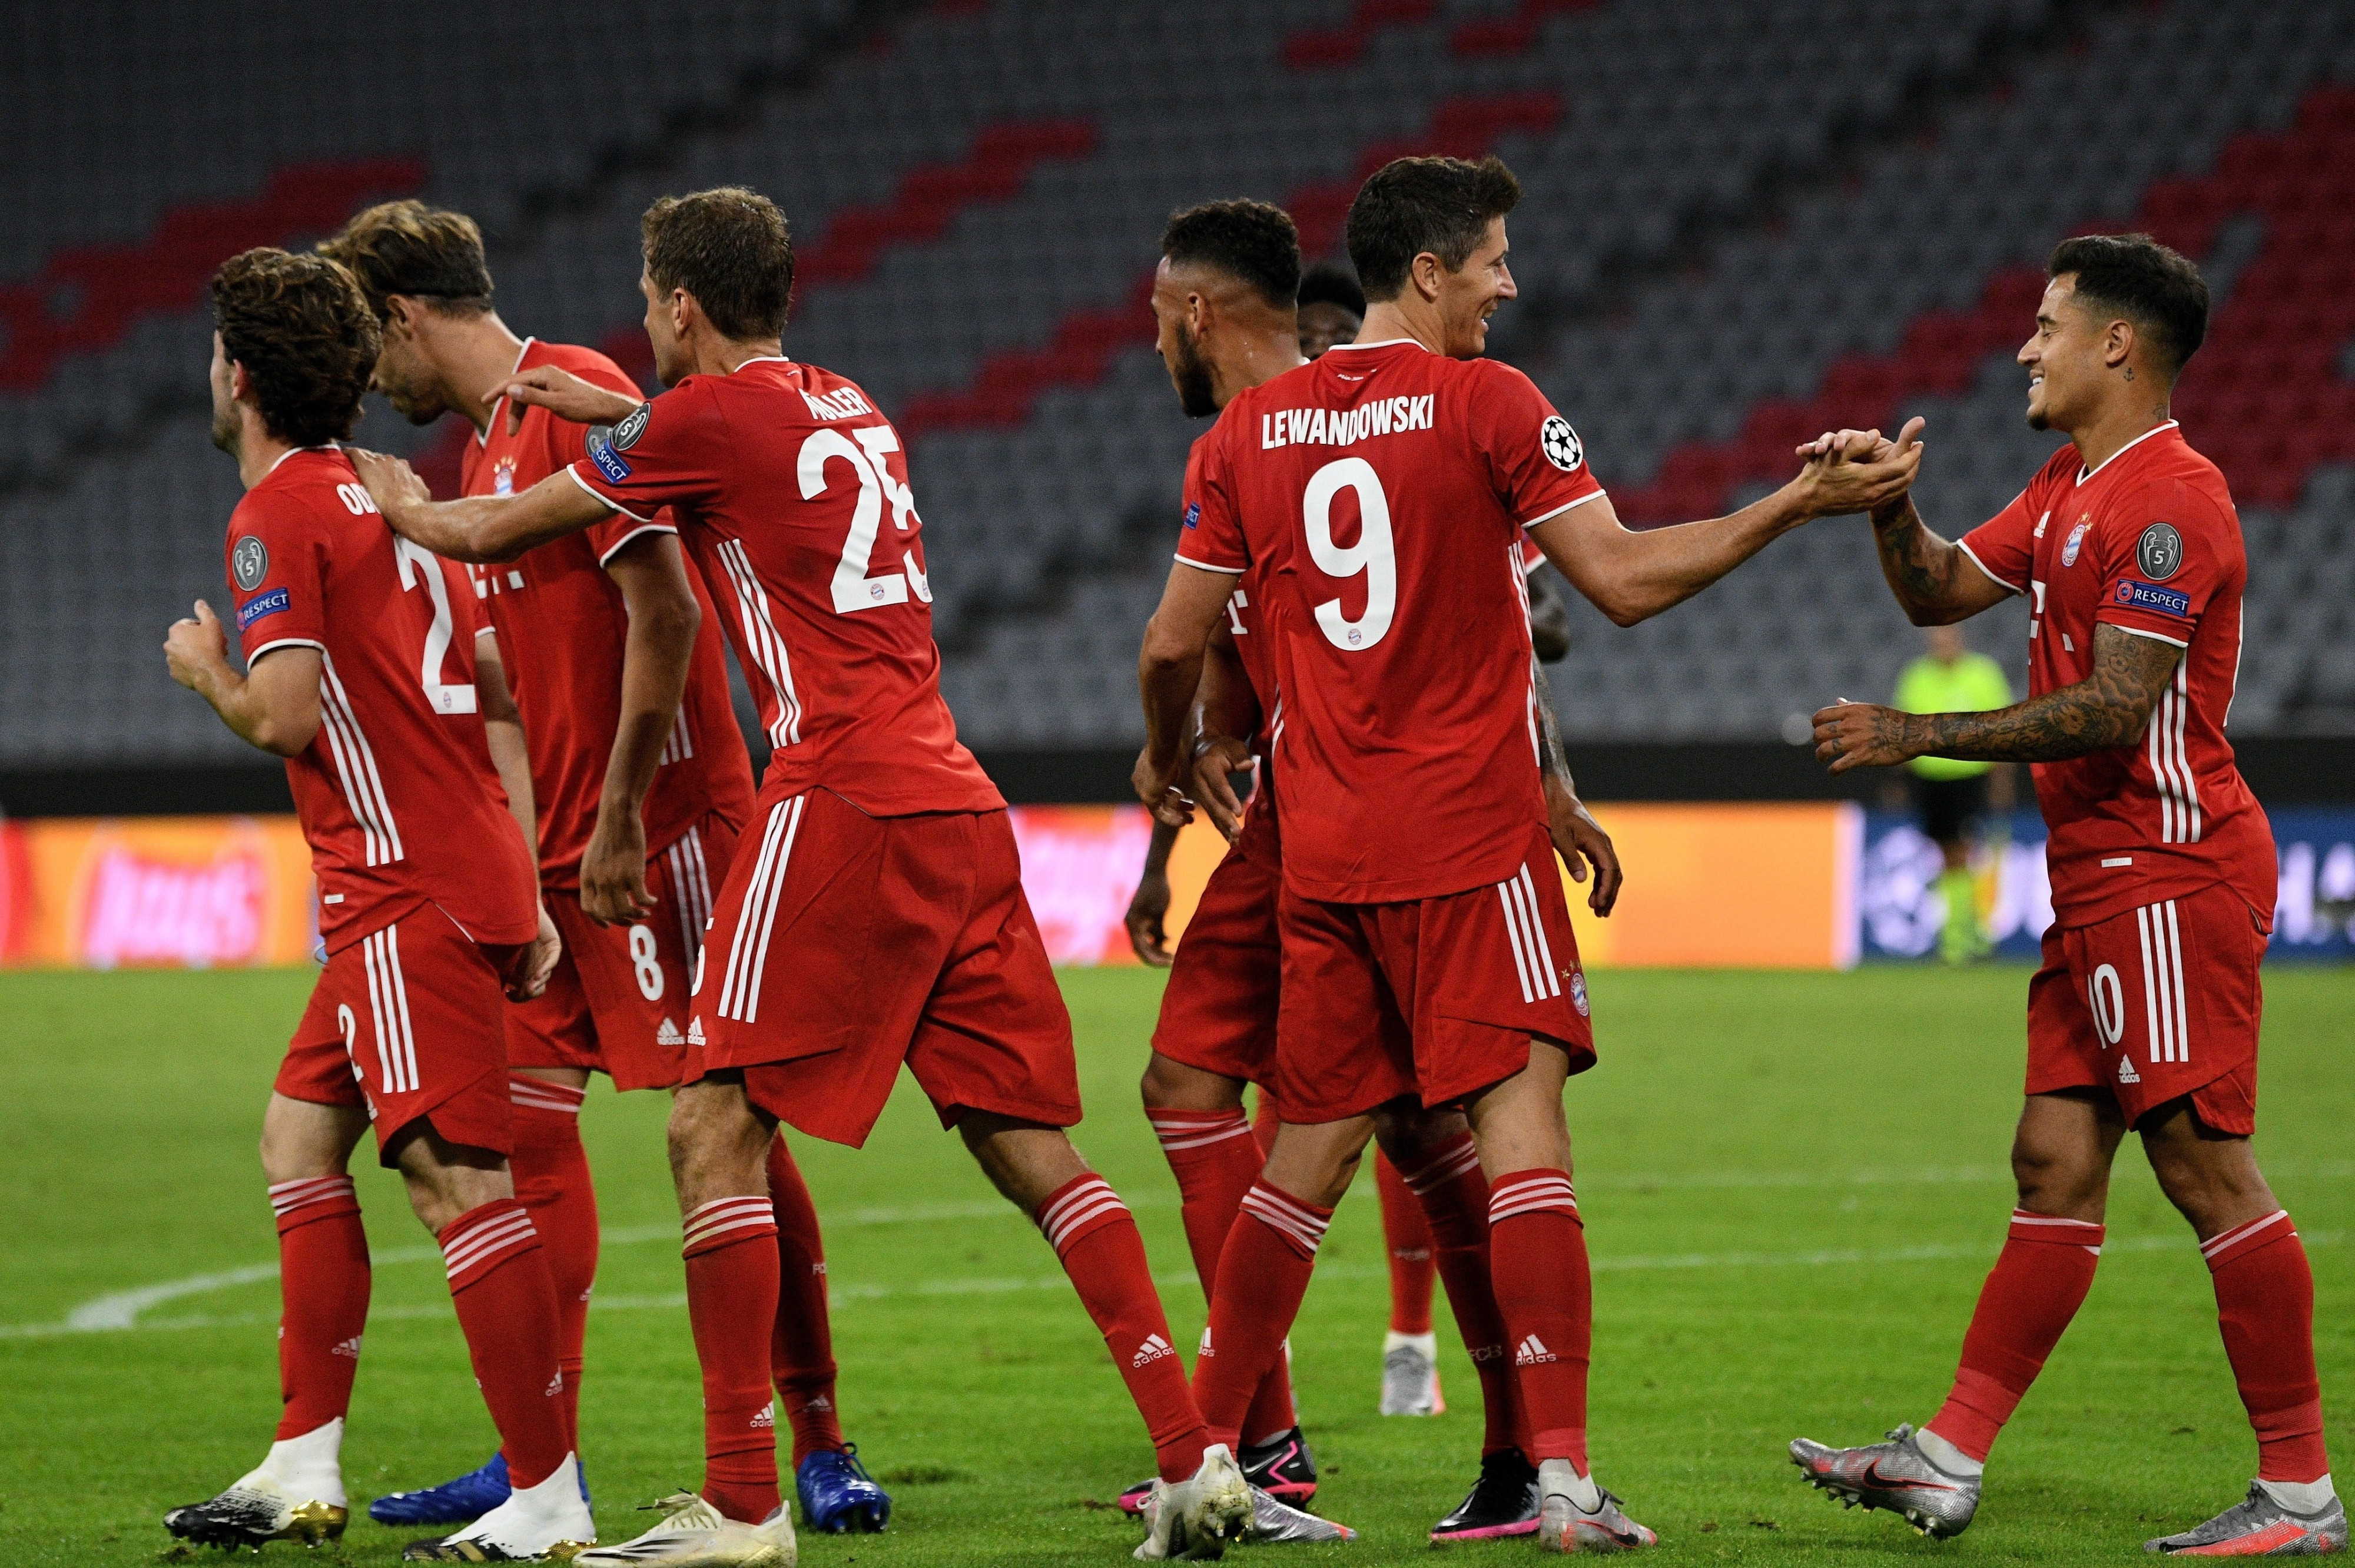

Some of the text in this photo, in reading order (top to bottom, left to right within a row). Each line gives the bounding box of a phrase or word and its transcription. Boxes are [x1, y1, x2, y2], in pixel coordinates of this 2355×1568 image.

[620, 422, 632, 436] 5
[1262, 394, 1434, 450] LEWANDOWSKI
[596, 447, 626, 480] SPECT
[336, 483, 382, 516] OD
[797, 425, 933, 614] 25
[246, 561, 254, 576] 5
[1303, 457, 1397, 651] 9
[2154, 551, 2165, 564] 5
[243, 594, 288, 621] RESPECT
[2134, 589, 2188, 611] RESPECT
[394, 535, 476, 714] 2
[629, 924, 664, 1001] 8
[2088, 963, 2124, 1049] 10
[338, 1003, 364, 1082] 2
[1133, 1347, 1175, 1368] adidas
